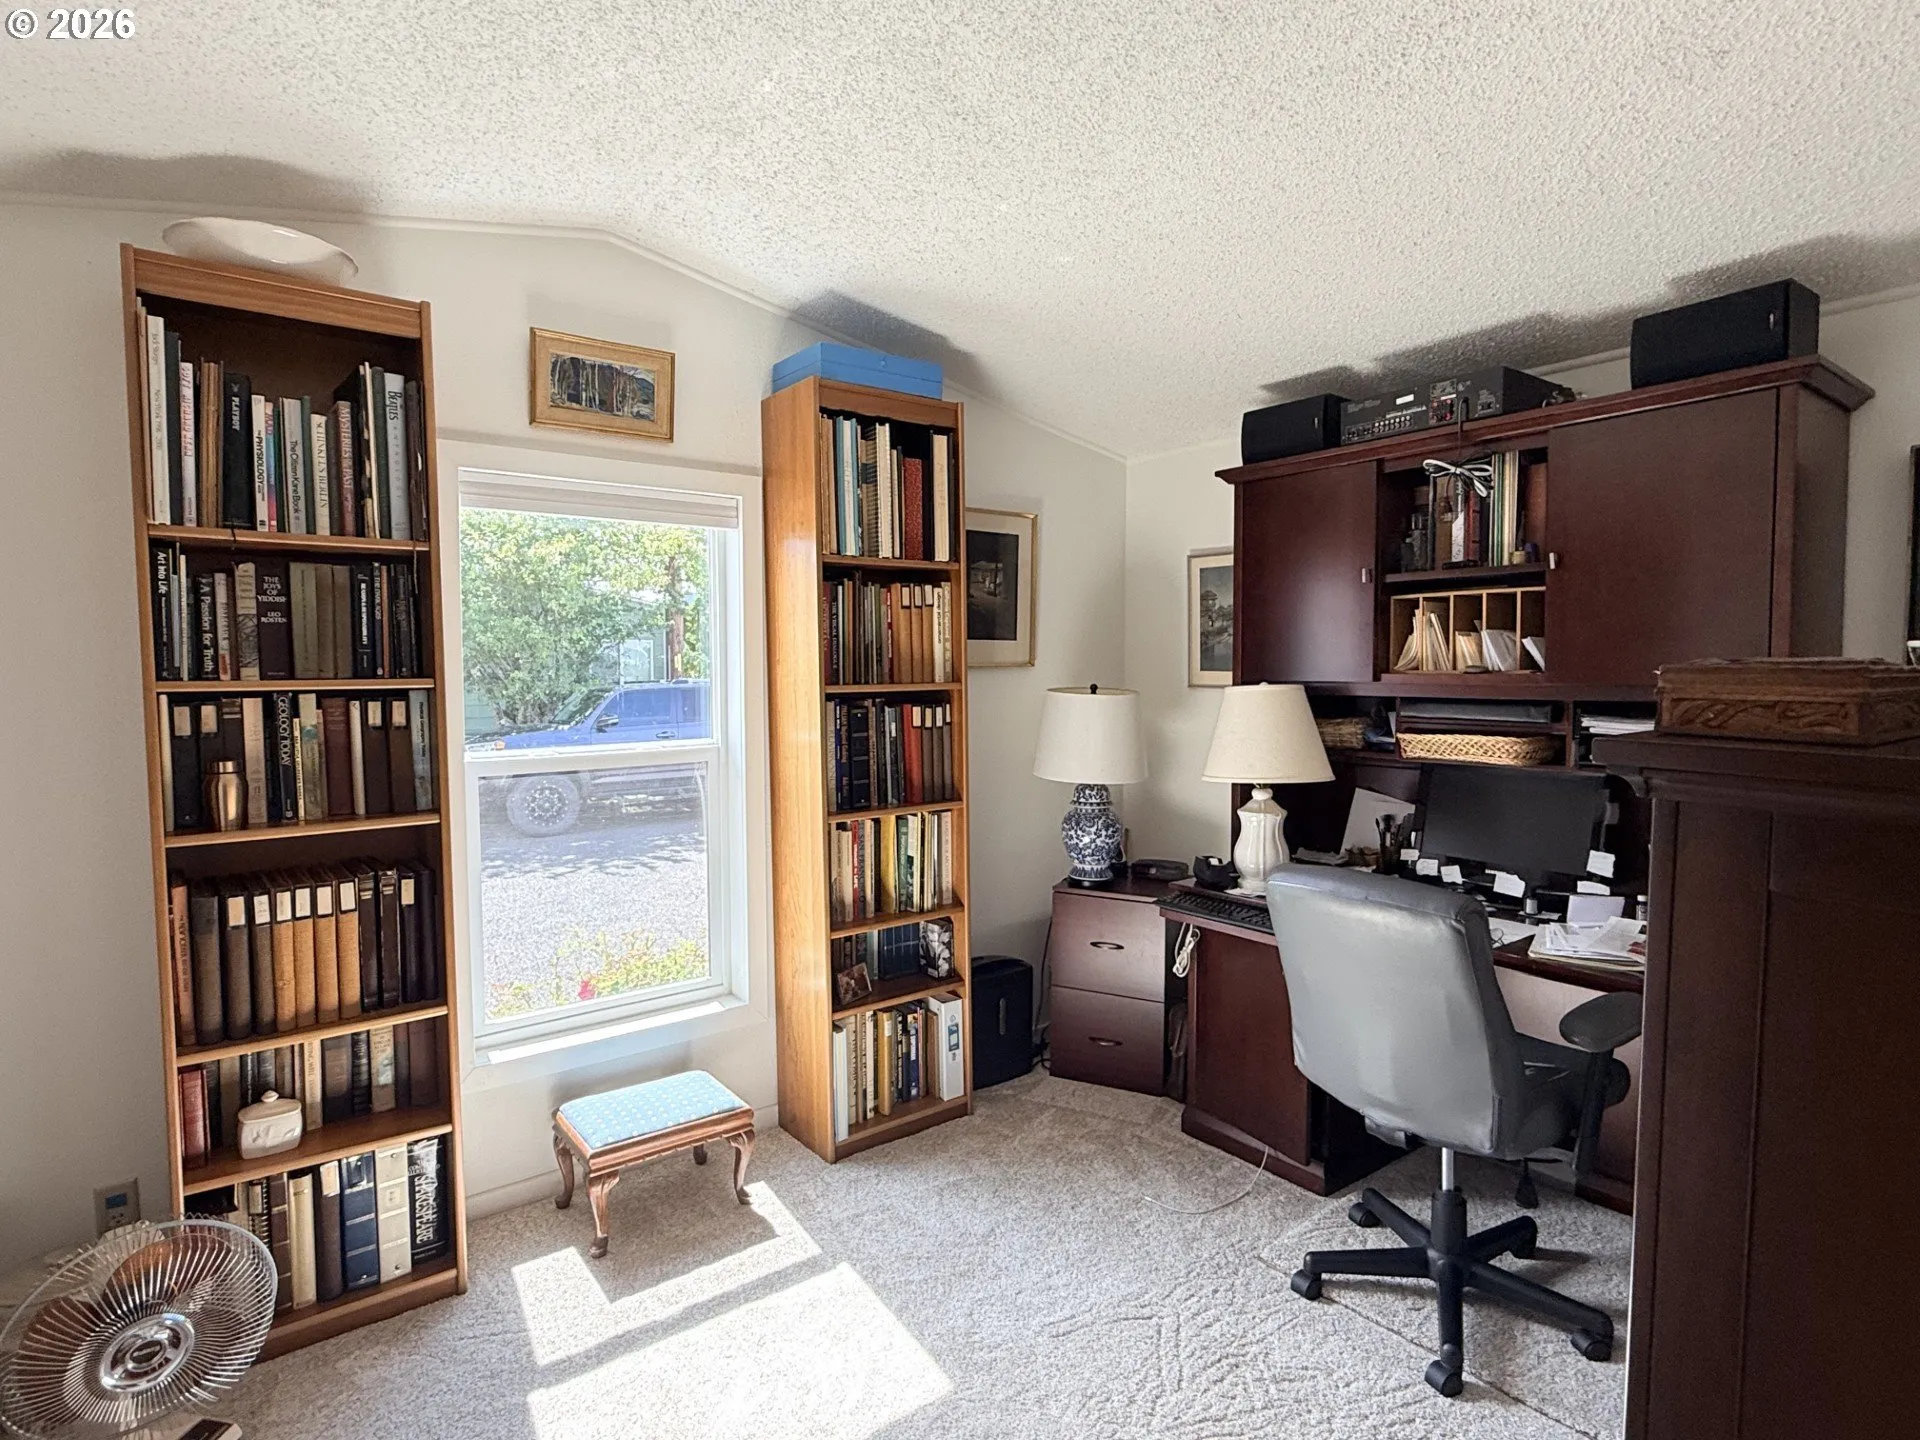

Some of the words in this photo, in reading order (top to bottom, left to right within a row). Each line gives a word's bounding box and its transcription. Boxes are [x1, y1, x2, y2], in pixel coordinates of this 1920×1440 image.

[231, 396, 240, 431] PLAYBOY
[385, 390, 402, 421] BEATLES
[265, 412, 273, 435] MAD
[337, 406, 352, 457] MYSTERIES
[290, 440, 299, 452] The
[256, 436, 265, 485] PHYSIOLOGY
[290, 453, 299, 476] Citizen
[291, 477, 300, 495] Kane
[343, 468, 353, 489] PAST
[318, 475, 328, 508] BERLIN
[292, 495, 301, 514] Book
[157, 551, 167, 564] Art
[158, 565, 167, 579] Into
[158, 580, 168, 594] Life
[200, 584, 211, 593] A
[200, 595, 212, 631] Passion
[202, 632, 213, 647] for
[203, 648, 214, 672] Truth
[278, 696, 291, 737] GEOLOGY
[279, 738, 292, 767] TODAY
[858, 854, 866, 903] FRANCISCO
[414, 1175, 434, 1244] SHAKESPEARE
